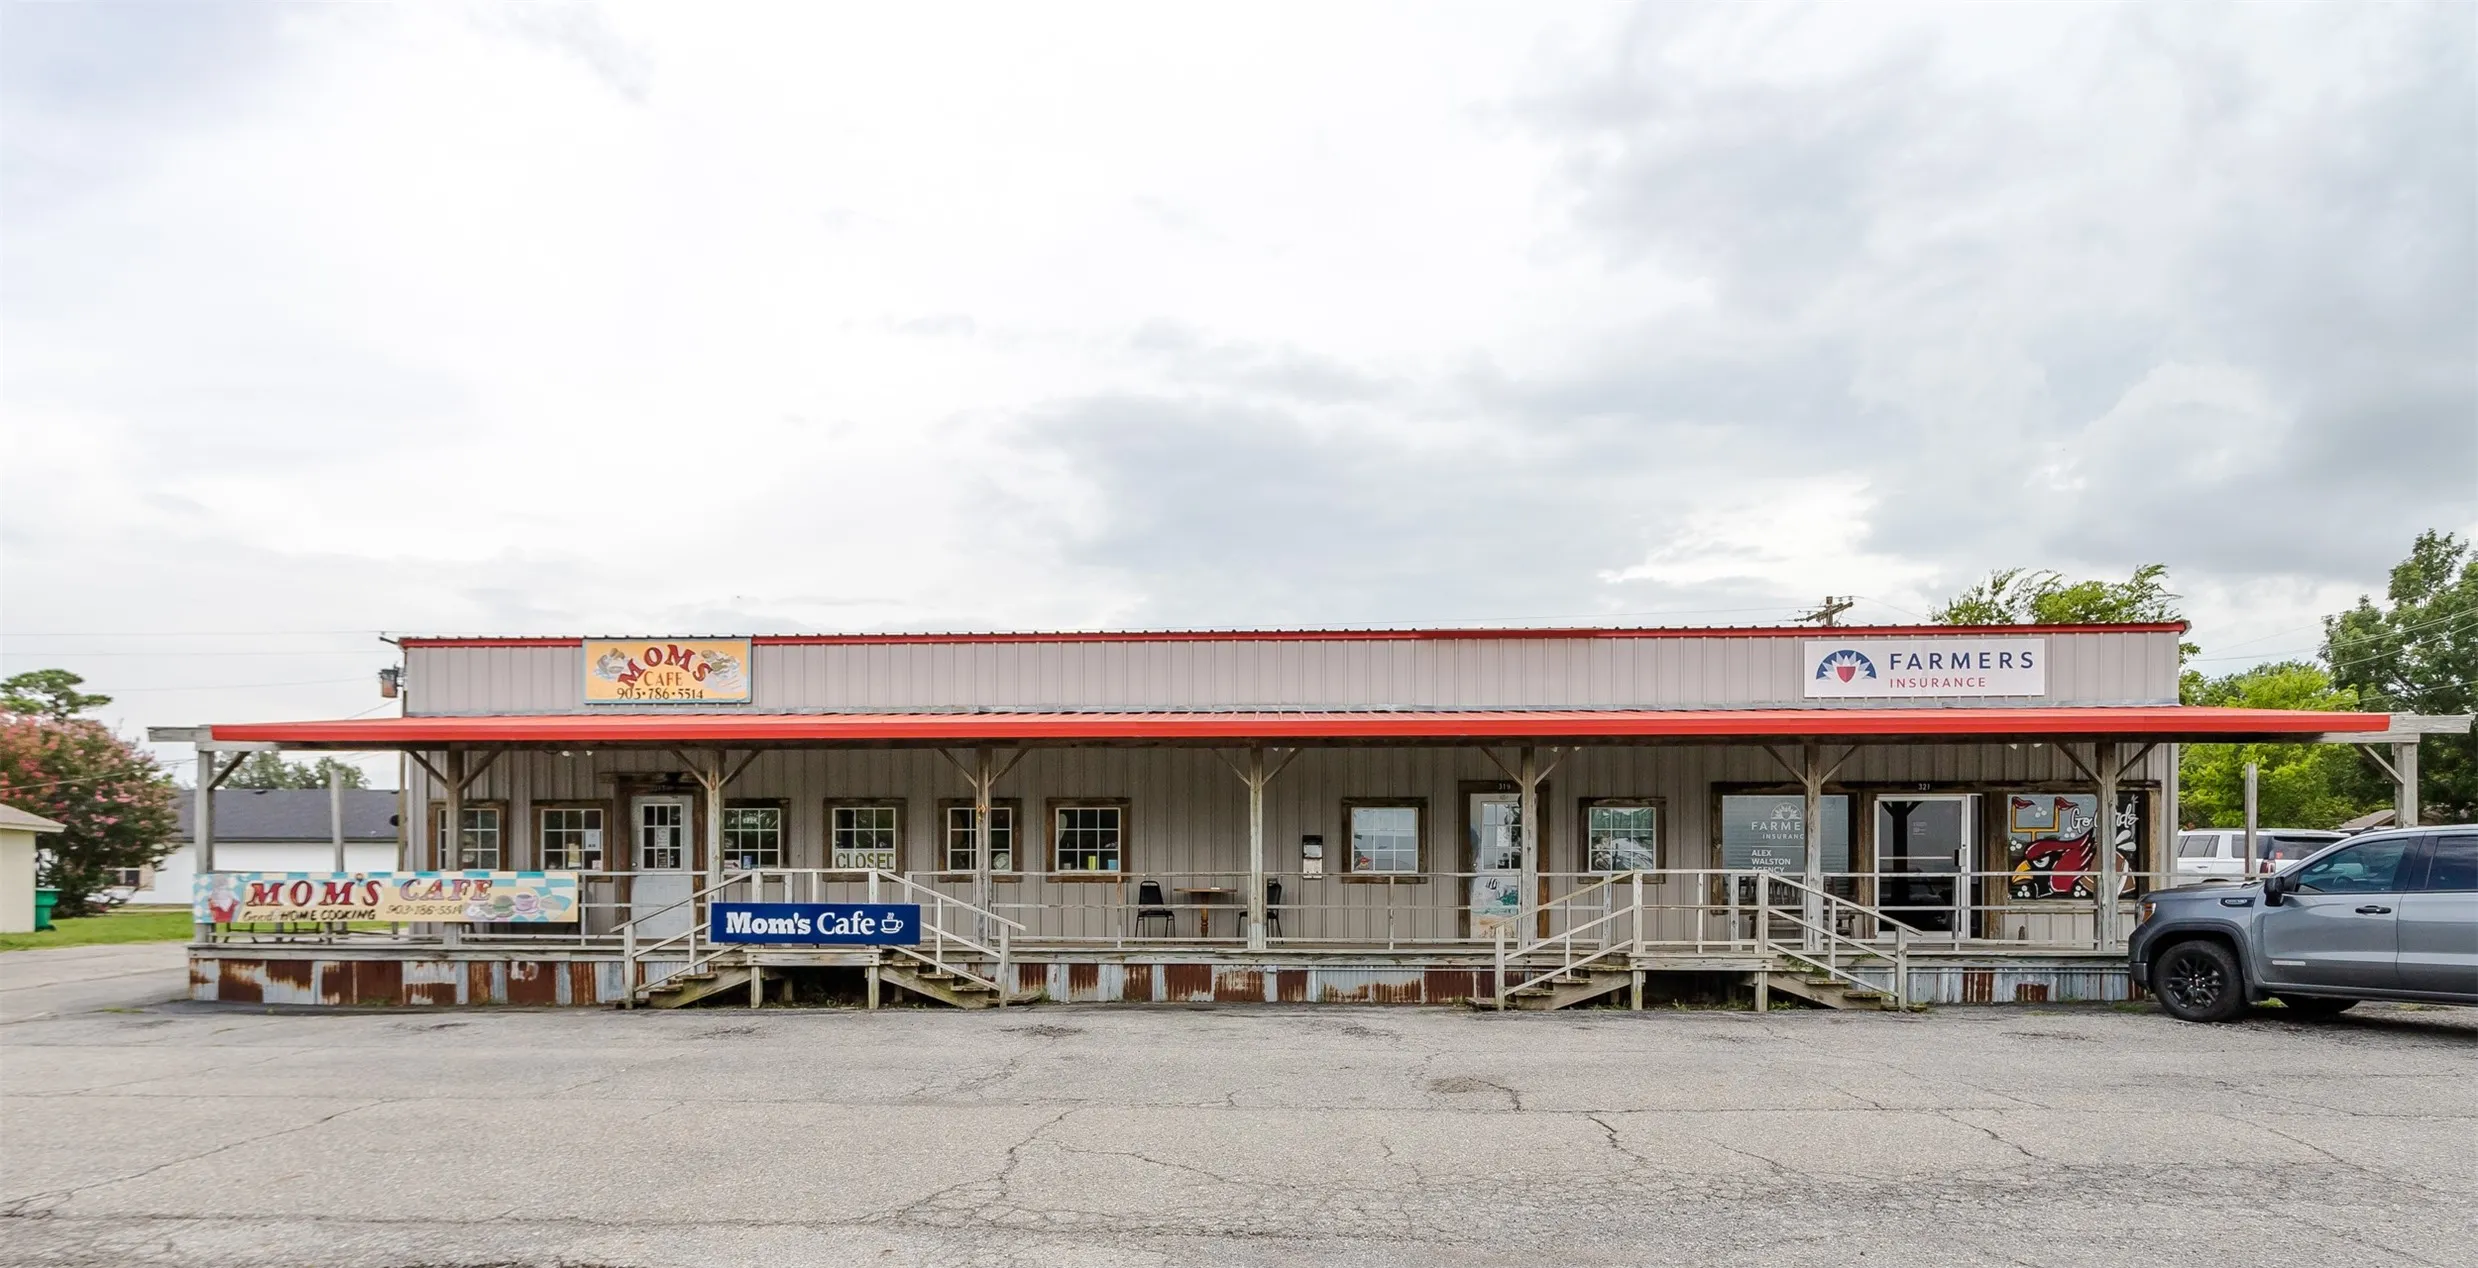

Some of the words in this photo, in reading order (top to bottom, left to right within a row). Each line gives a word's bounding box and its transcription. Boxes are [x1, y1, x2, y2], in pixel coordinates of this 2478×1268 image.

[617, 644, 713, 688] MOMS
[1889, 651, 2034, 670] FARMERS
[643, 671, 683, 687] CAFE
[1889, 677, 1986, 688] INSURANCE
[1752, 822, 1801, 831] FARME
[2070, 806, 2093, 833] Go
[399, 879, 493, 902] CAFE
[281, 909, 317, 921] HOME
[321, 909, 376, 921] COOKING
[725, 911, 811, 935] Mom's
[816, 910, 876, 935] Cafe
